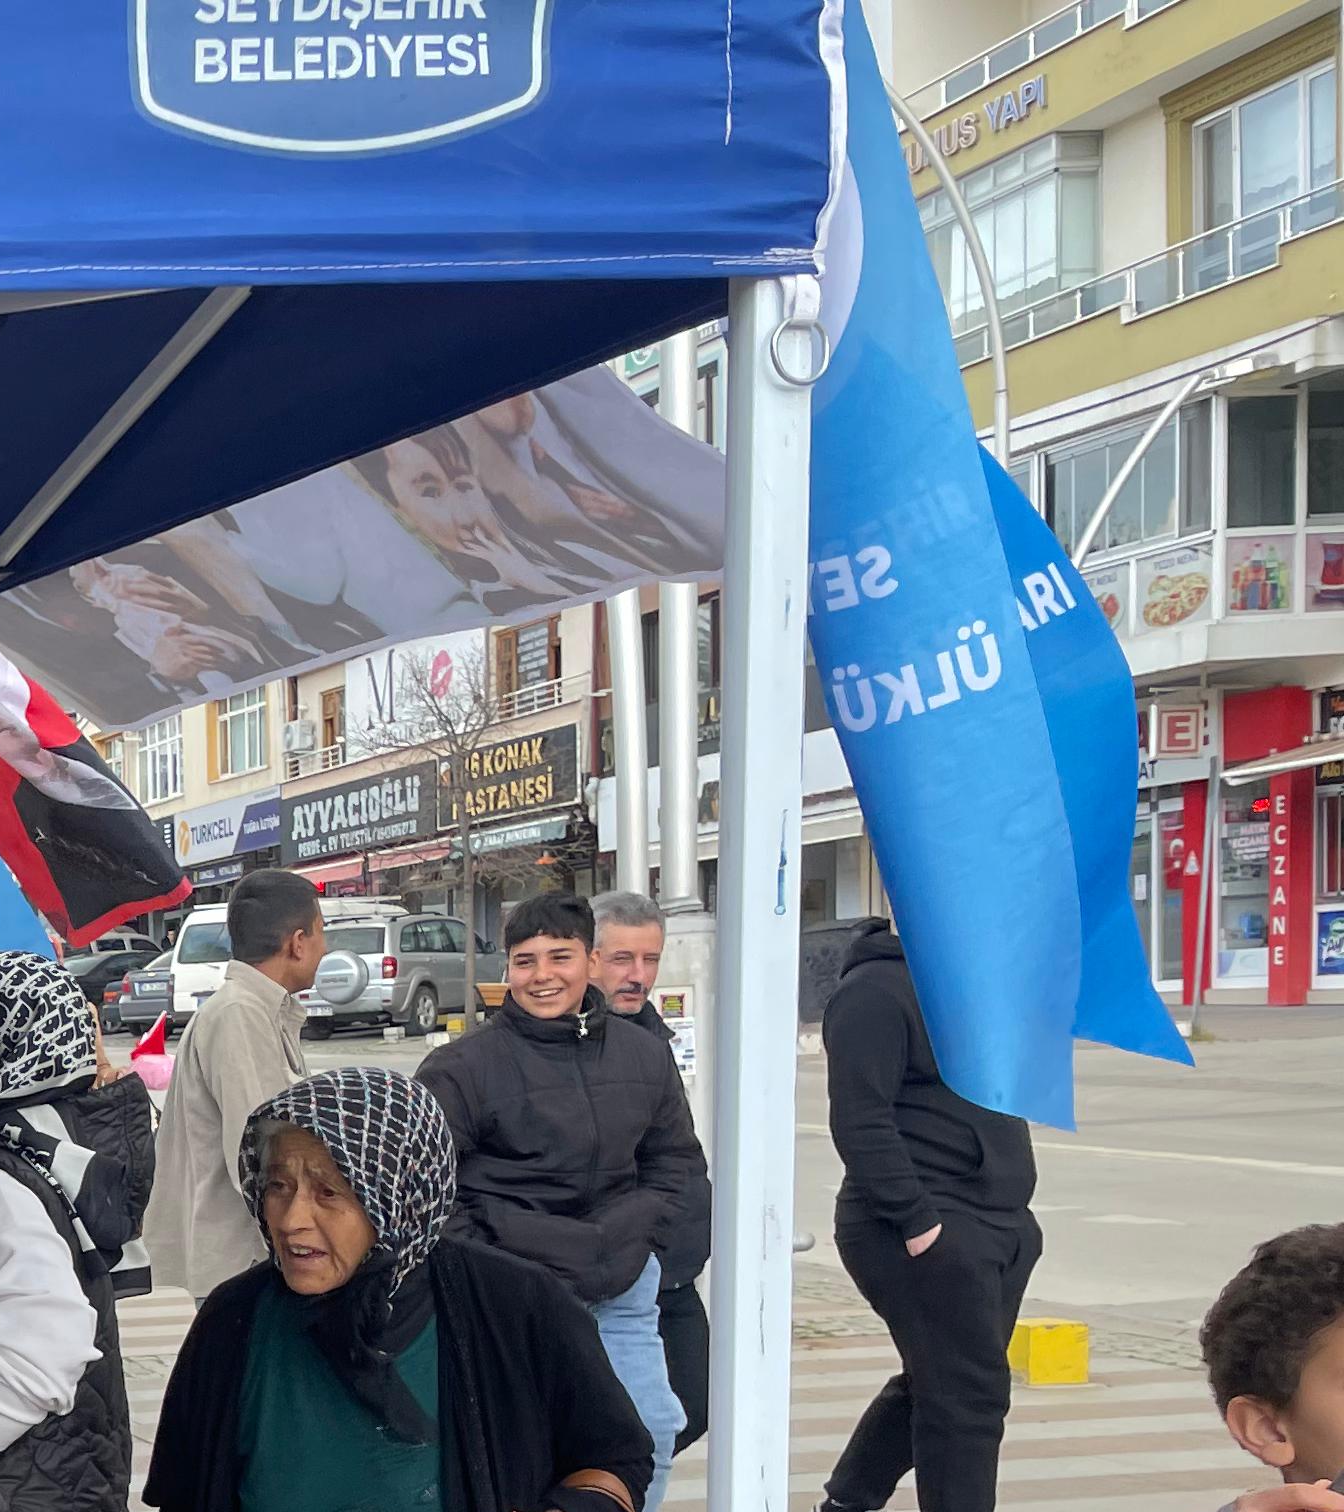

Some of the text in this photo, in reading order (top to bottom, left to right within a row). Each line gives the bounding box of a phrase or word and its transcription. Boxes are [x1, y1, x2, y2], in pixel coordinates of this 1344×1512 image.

[193, 32, 490, 83] BELEDİYESİ
[983, 74, 1047, 132] YAPI
[482, 736, 543, 777] KONAK
[190, 816, 234, 846] TURKCELL
[1272, 795, 1287, 966] ECZANE
